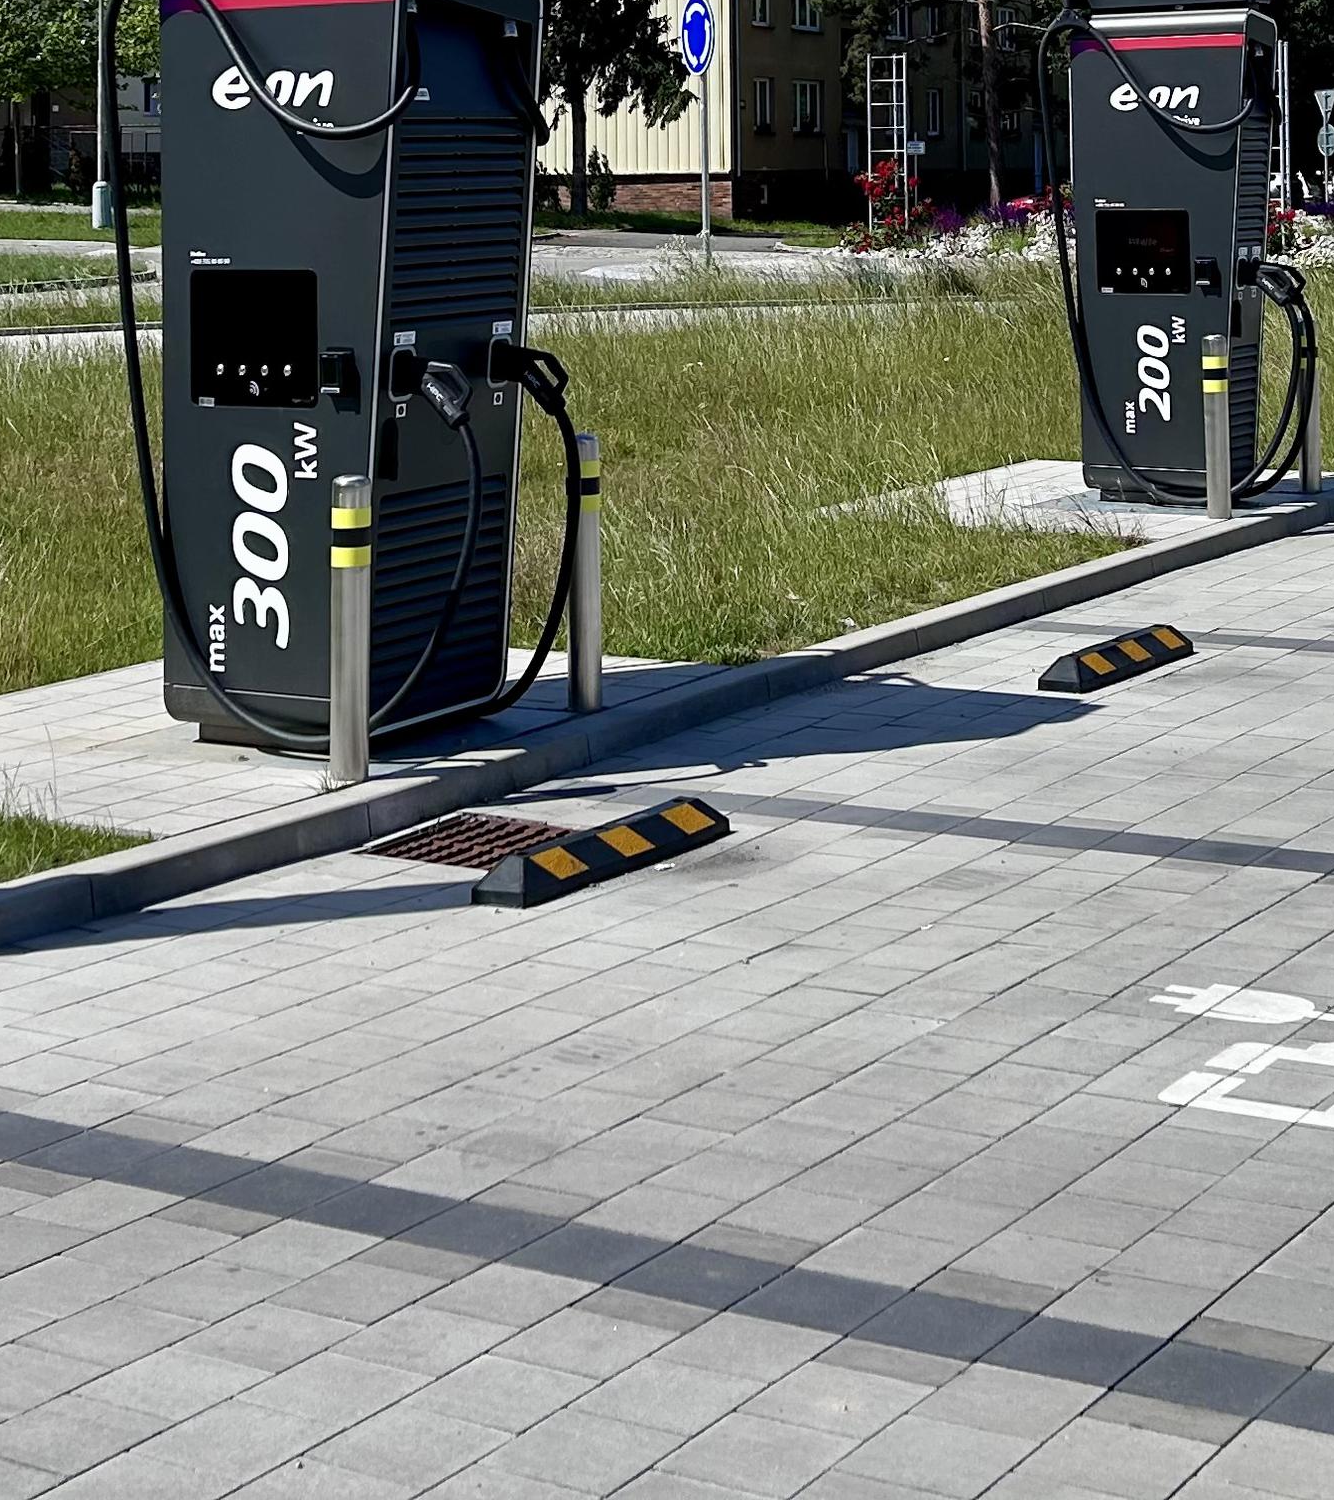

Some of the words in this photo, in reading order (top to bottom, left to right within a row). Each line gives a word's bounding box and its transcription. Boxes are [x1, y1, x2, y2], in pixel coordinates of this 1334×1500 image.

[211, 65, 335, 110] eon
[1109, 82, 1200, 112] eon
[1171, 315, 1186, 344] kW
[426, 381, 445, 402] HPC
[1136, 324, 1171, 422] 200
[1125, 401, 1136, 434] max
[293, 421, 318, 480] kW
[231, 443, 290, 650] 300
[208, 603, 226, 673] max
